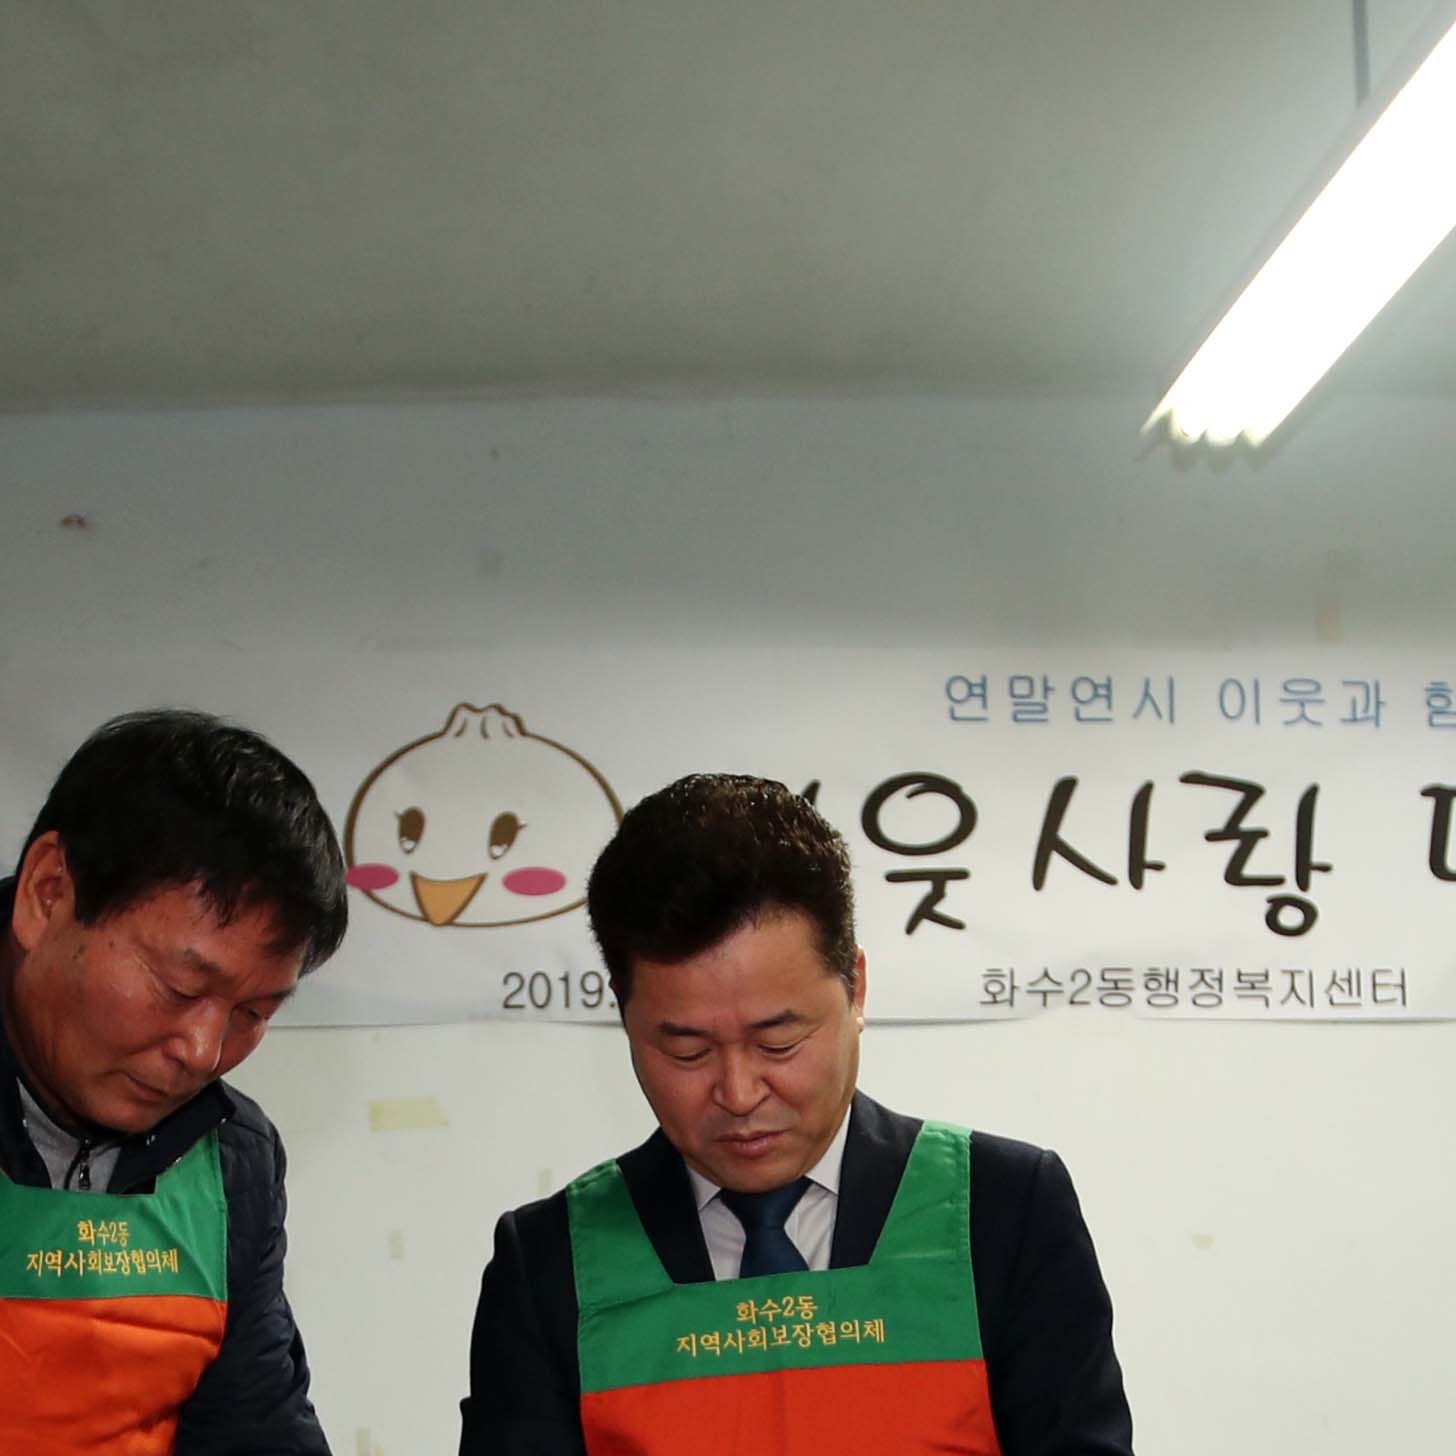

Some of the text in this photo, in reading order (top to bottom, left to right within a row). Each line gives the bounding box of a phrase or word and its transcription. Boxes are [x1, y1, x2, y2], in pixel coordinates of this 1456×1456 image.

[945, 675, 1177, 724] 연말연시
[1219, 676, 1387, 728] 이웃과
[802, 771, 1332, 937] 웃사랑
[979, 967, 1408, 1010] 화수2동행정복지센터
[76, 1219, 131, 1248] 화수2동
[26, 1248, 180, 1277] 지역사회보장협의체
[735, 1295, 819, 1324] 화수2동
[676, 1318, 886, 1358] 지역사회보장협의체
